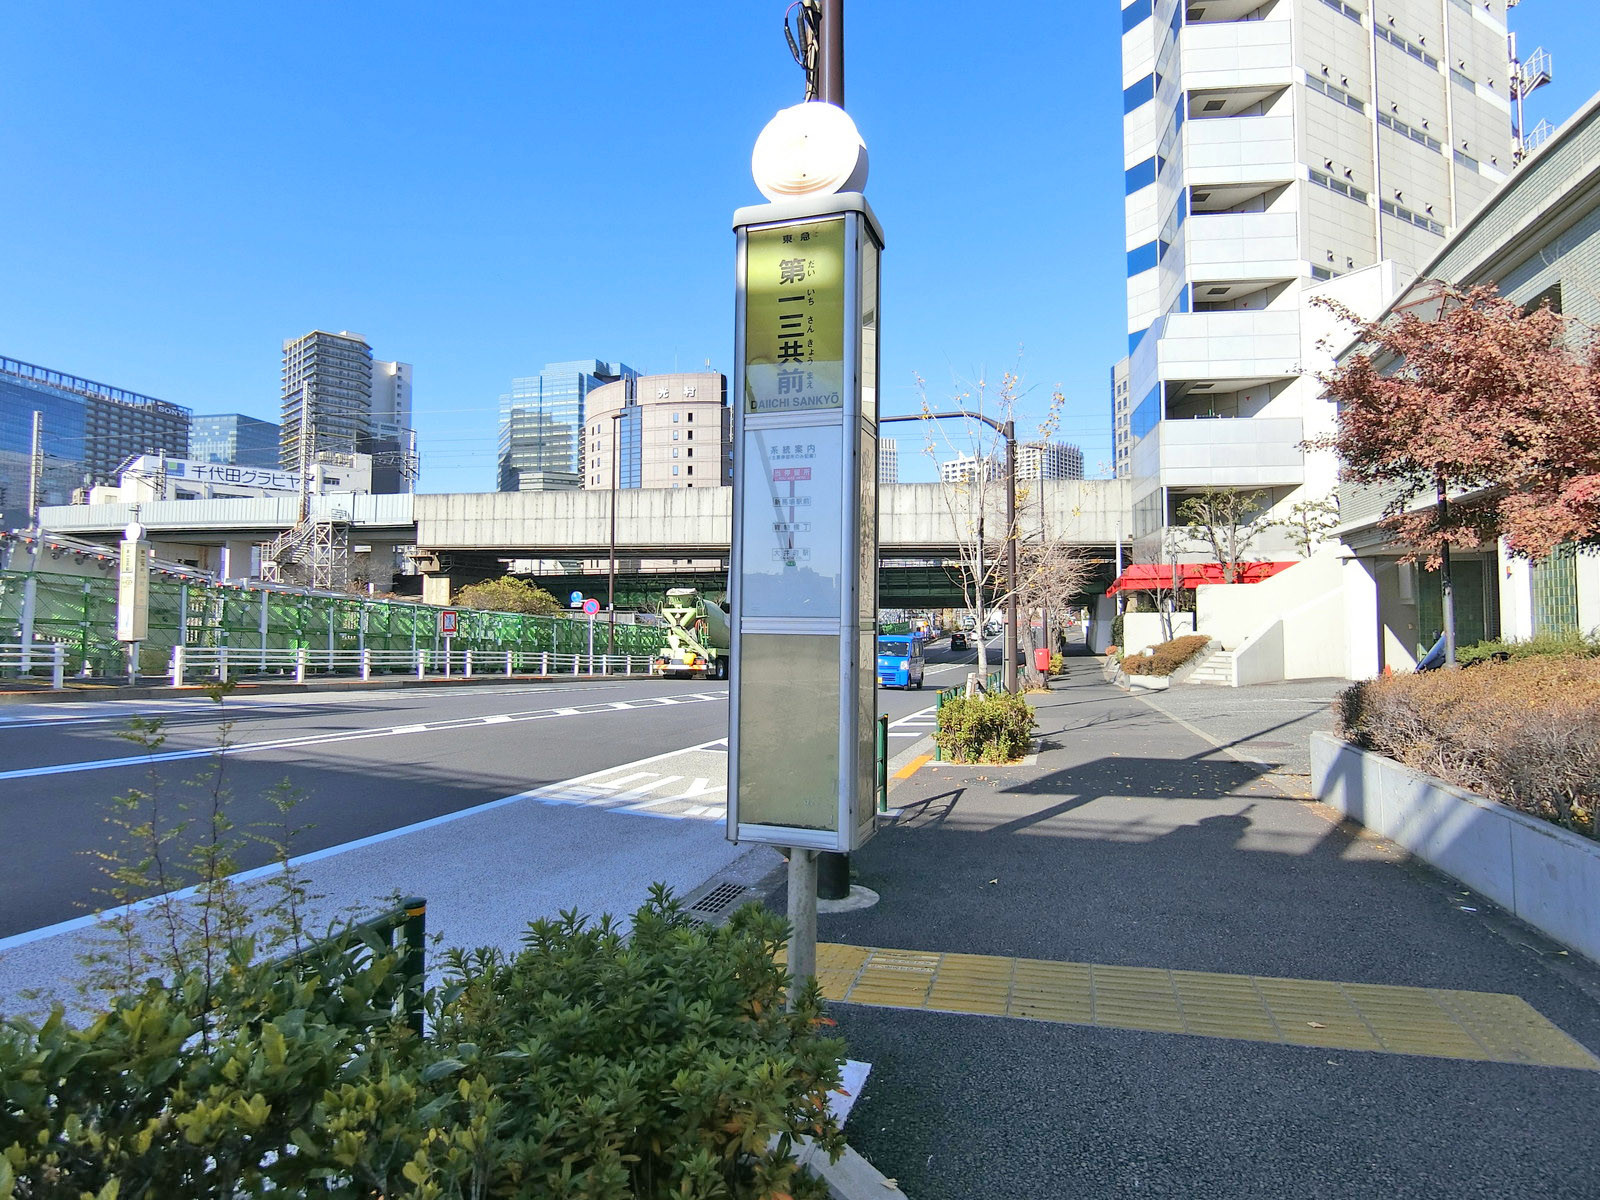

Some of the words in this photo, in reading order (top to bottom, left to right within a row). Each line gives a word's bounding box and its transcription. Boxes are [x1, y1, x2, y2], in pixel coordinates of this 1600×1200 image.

[782, 232, 811, 244] 東急
[777, 258, 806, 395] 第一三共前
[658, 385, 697, 399] 光村
[750, 397, 790, 410] DAIICHI
[792, 391, 840, 407] SANKYŌ
[158, 405, 184, 418] SONY
